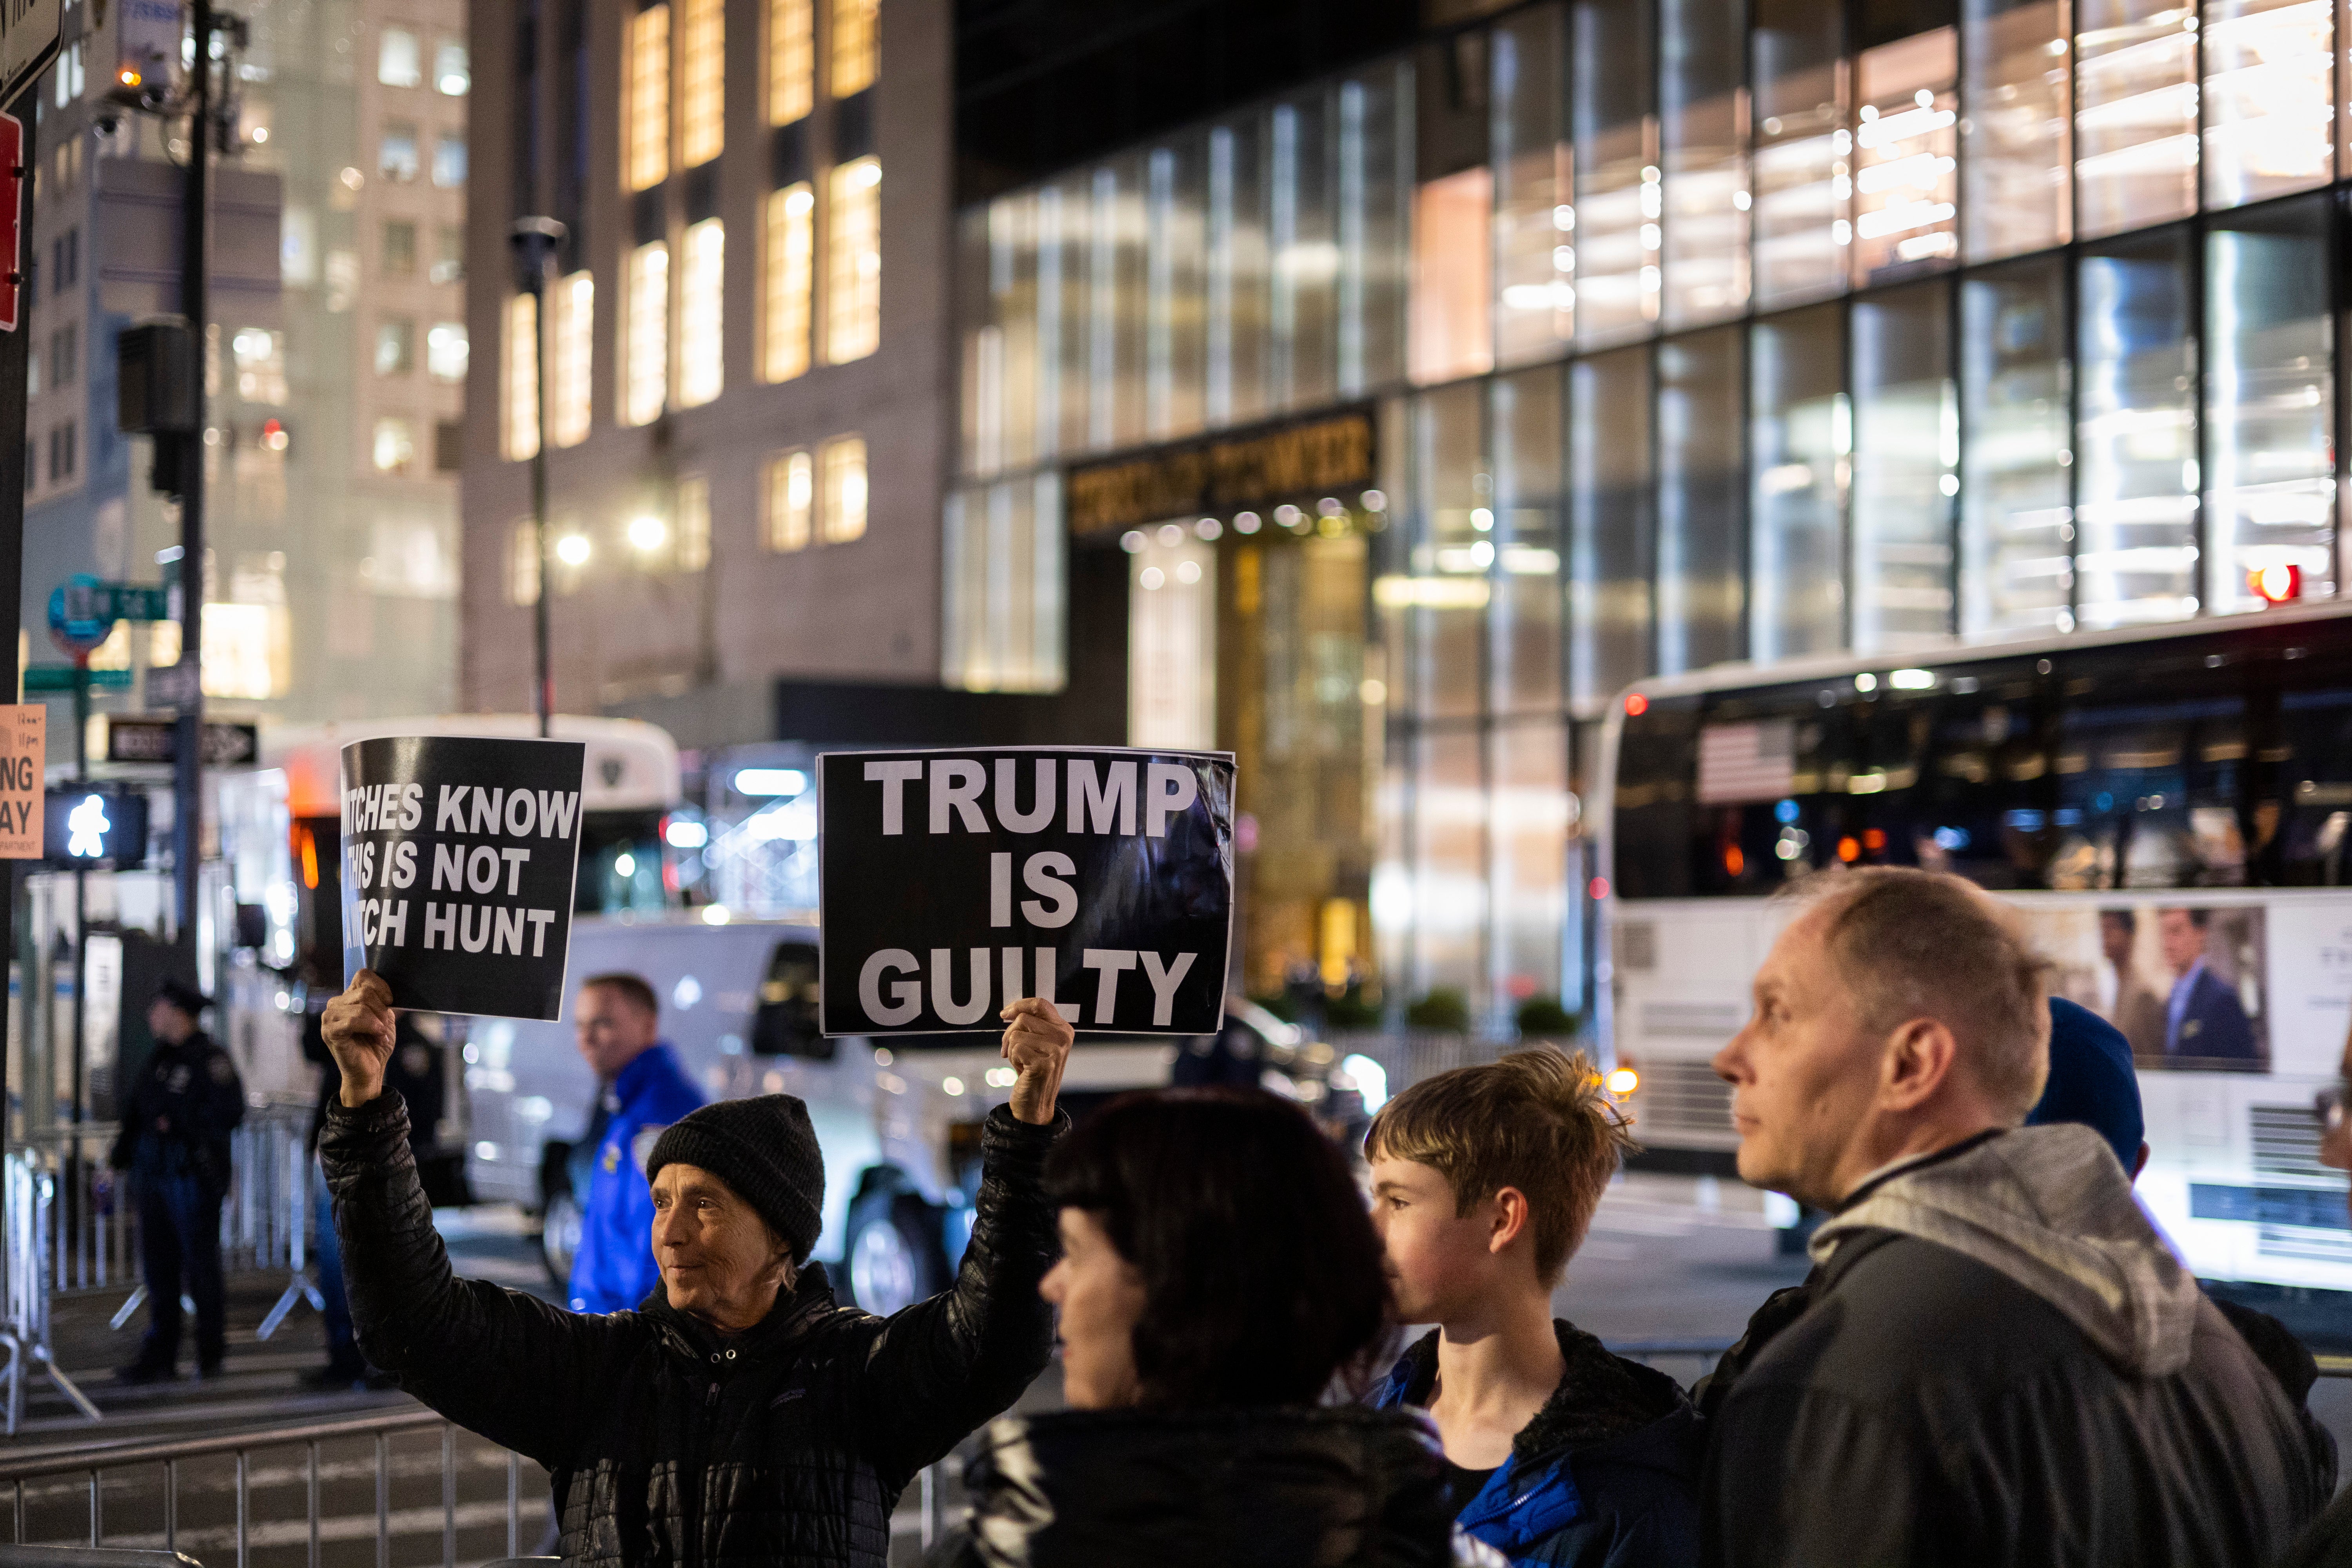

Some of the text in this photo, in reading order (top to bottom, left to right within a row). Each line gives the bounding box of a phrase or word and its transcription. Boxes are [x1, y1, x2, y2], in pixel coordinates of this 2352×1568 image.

[0, 757, 33, 791] NG
[864, 759, 1198, 837] TRUMP
[0, 801, 32, 835] AY
[436, 785, 579, 839] KNOW
[347, 841, 530, 895] THIS IS NOT
[990, 851, 1078, 928] IS
[424, 901, 555, 957] HUNT
[858, 946, 1198, 1026] GUILTY
